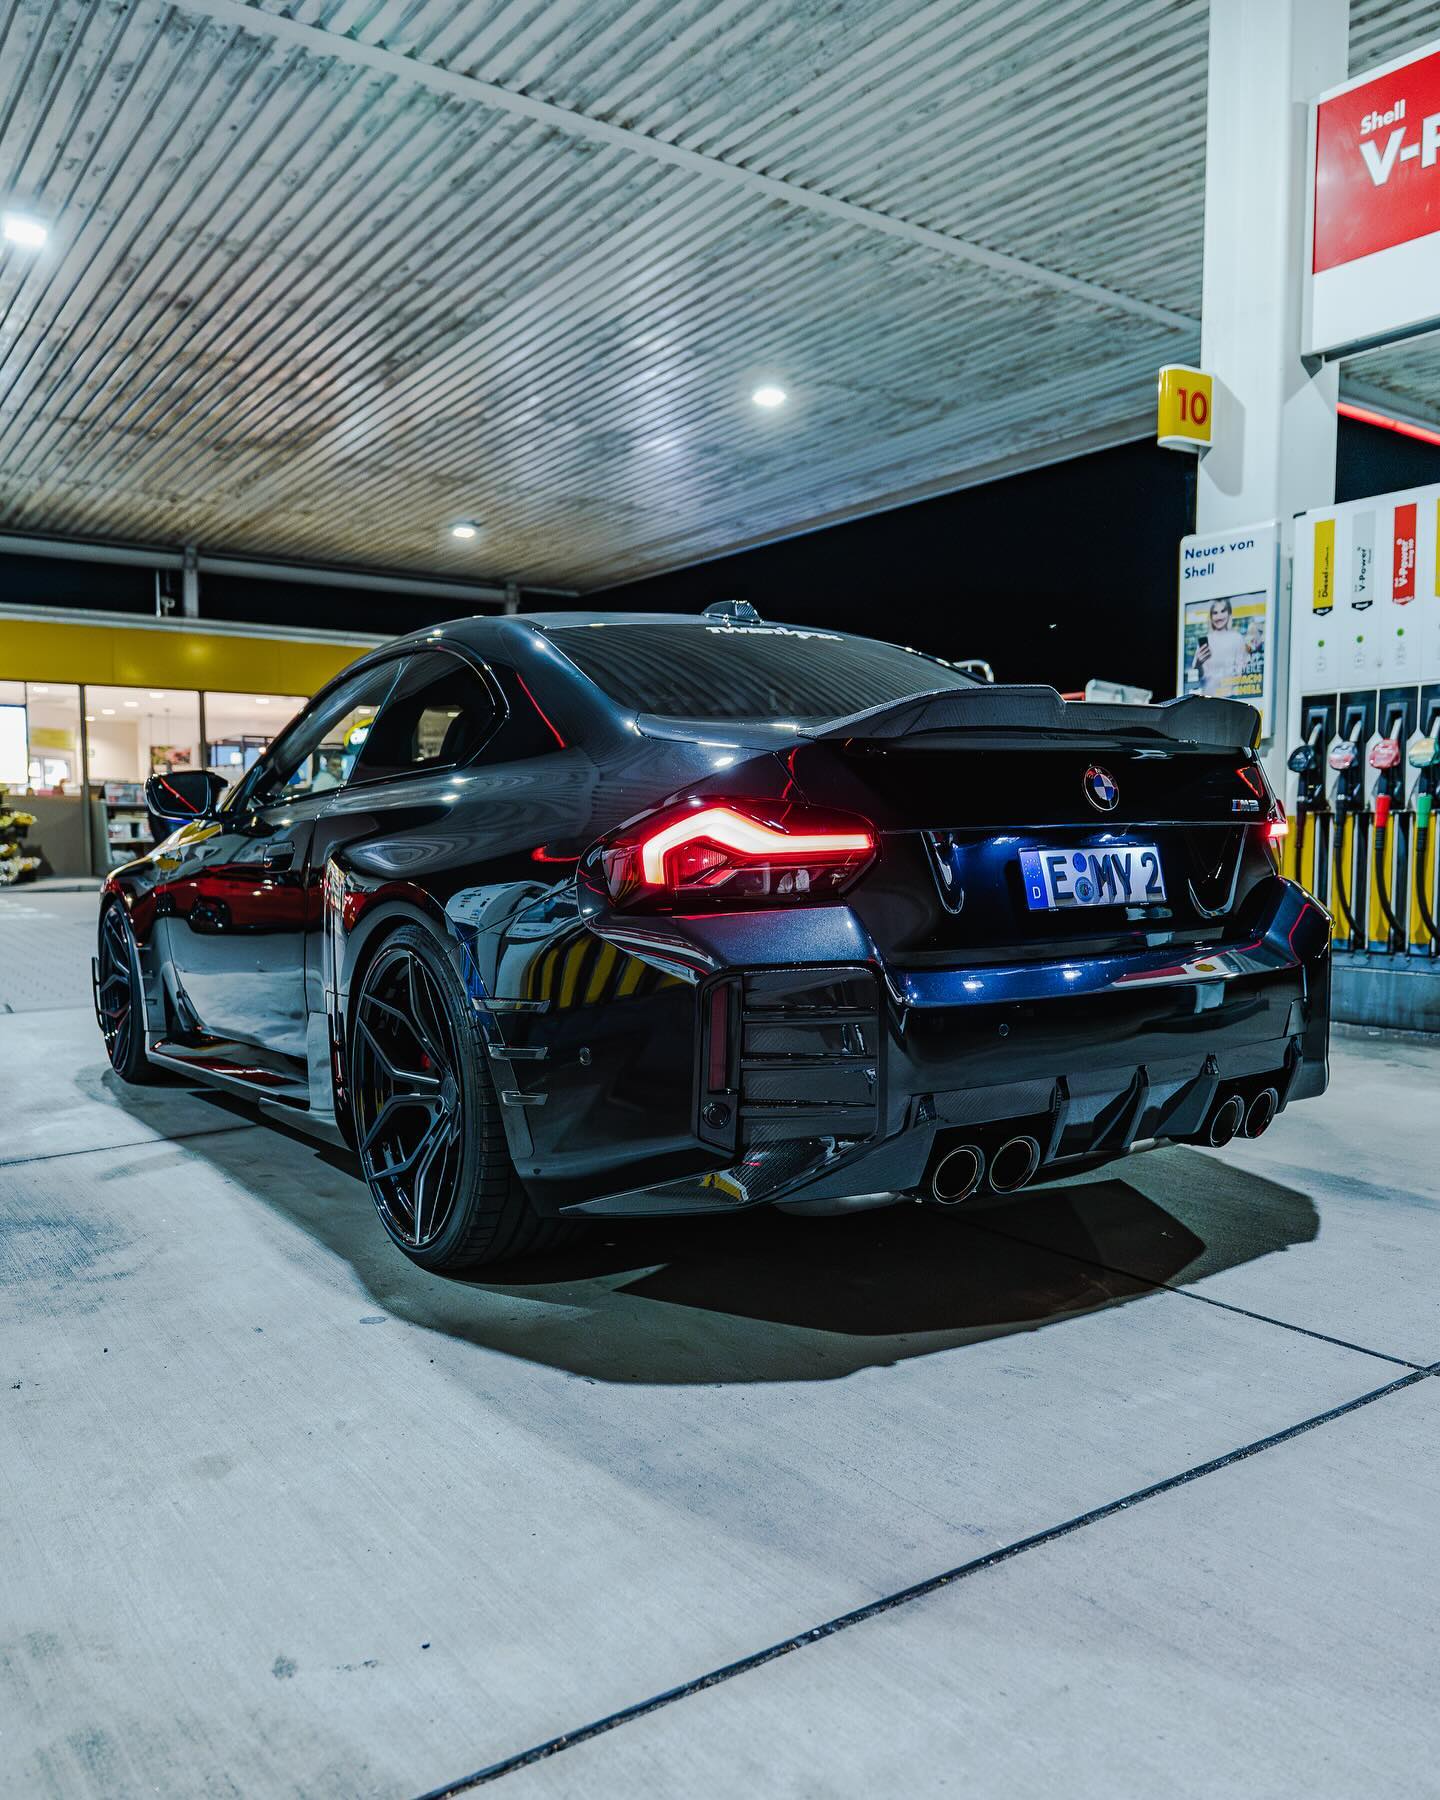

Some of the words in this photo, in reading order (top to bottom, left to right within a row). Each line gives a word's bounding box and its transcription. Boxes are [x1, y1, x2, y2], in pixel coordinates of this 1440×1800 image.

[1360, 98, 1406, 136] Shell
[1178, 388, 1208, 425] 10
[1184, 544, 1225, 560] Neues
[1230, 538, 1255, 551] von
[1184, 563, 1215, 579] Shell
[1046, 855, 1073, 900] E
[1089, 853, 1132, 898] MY
[1141, 851, 1162, 894] 2
[1032, 886, 1042, 899] D
